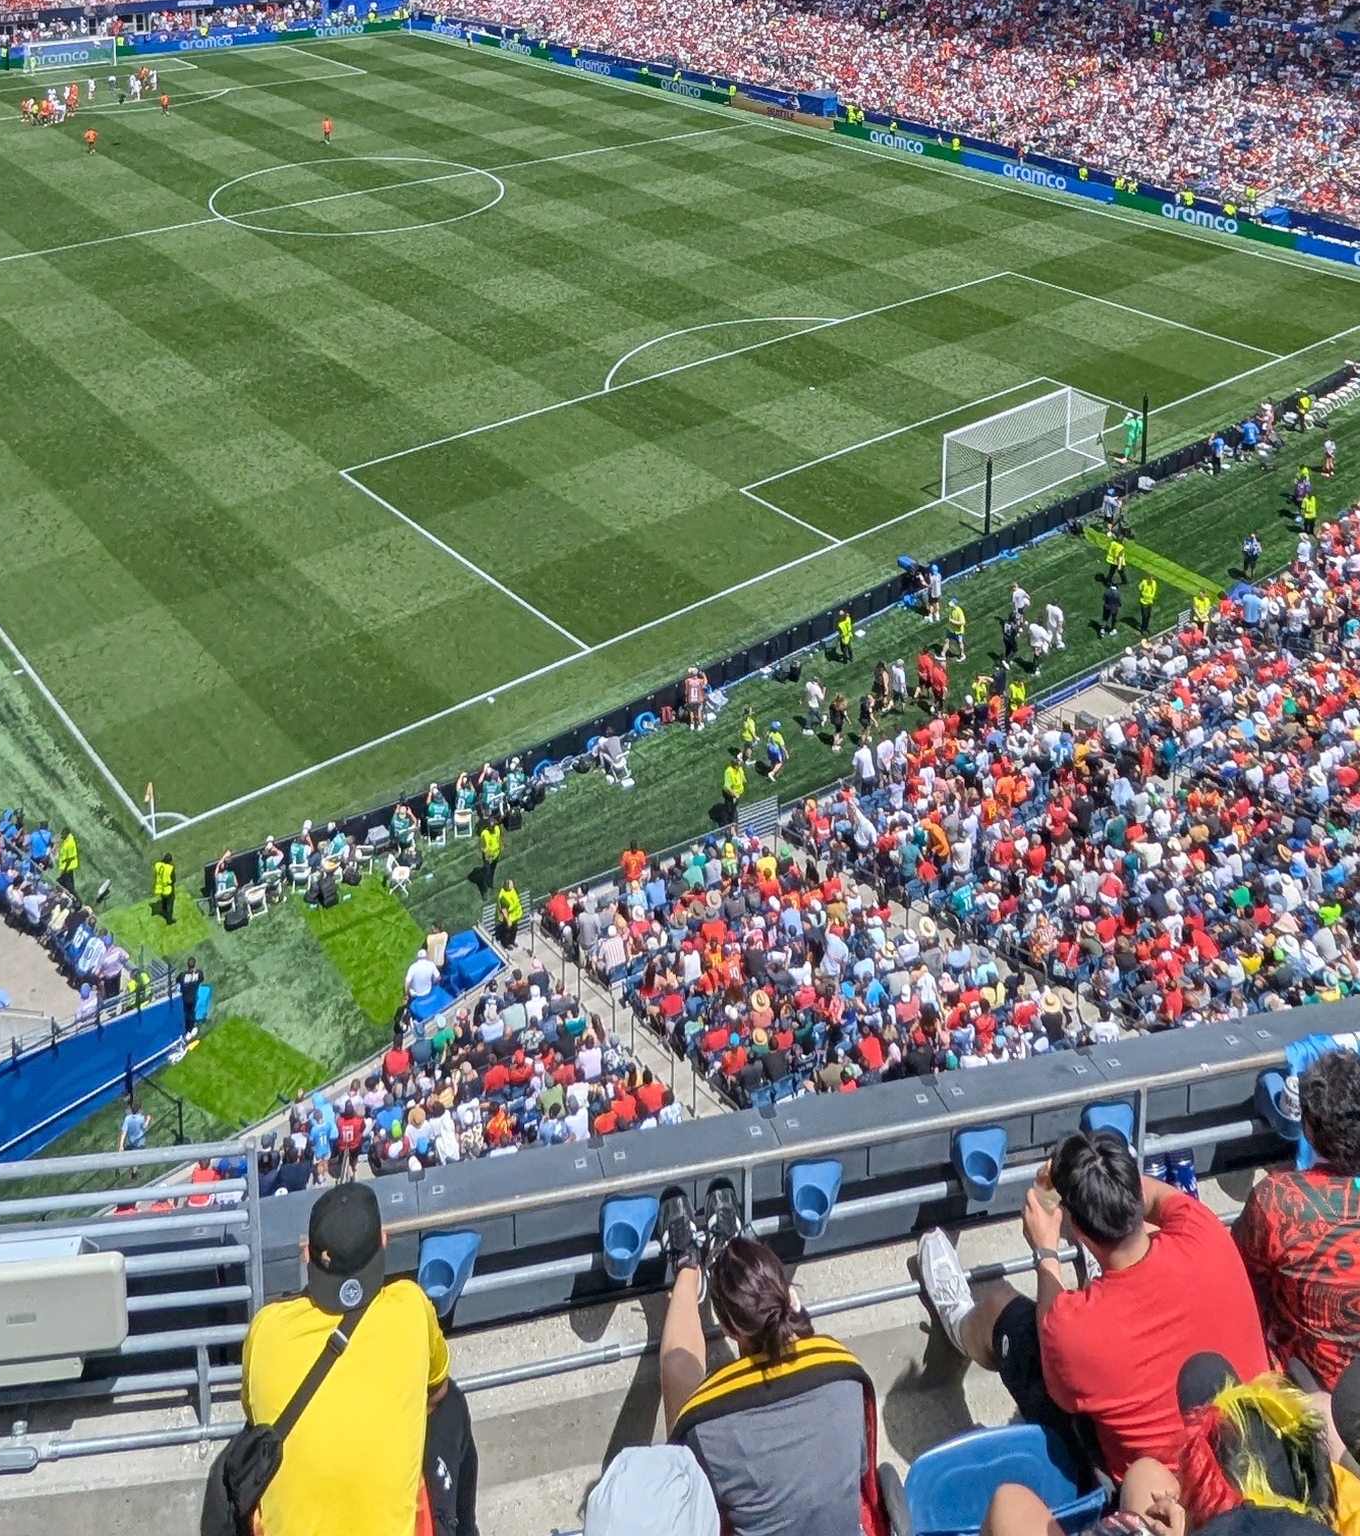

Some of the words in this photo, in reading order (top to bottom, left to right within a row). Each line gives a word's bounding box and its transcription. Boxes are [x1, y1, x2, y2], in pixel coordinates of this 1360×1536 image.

[315, 24, 364, 38] aramco
[180, 35, 233, 50] aramco
[575, 58, 611, 75] aramco
[660, 78, 701, 98] aramco
[869, 130, 924, 154] aramco
[1003, 163, 1067, 190] aramco
[1162, 203, 1238, 234] aramco
